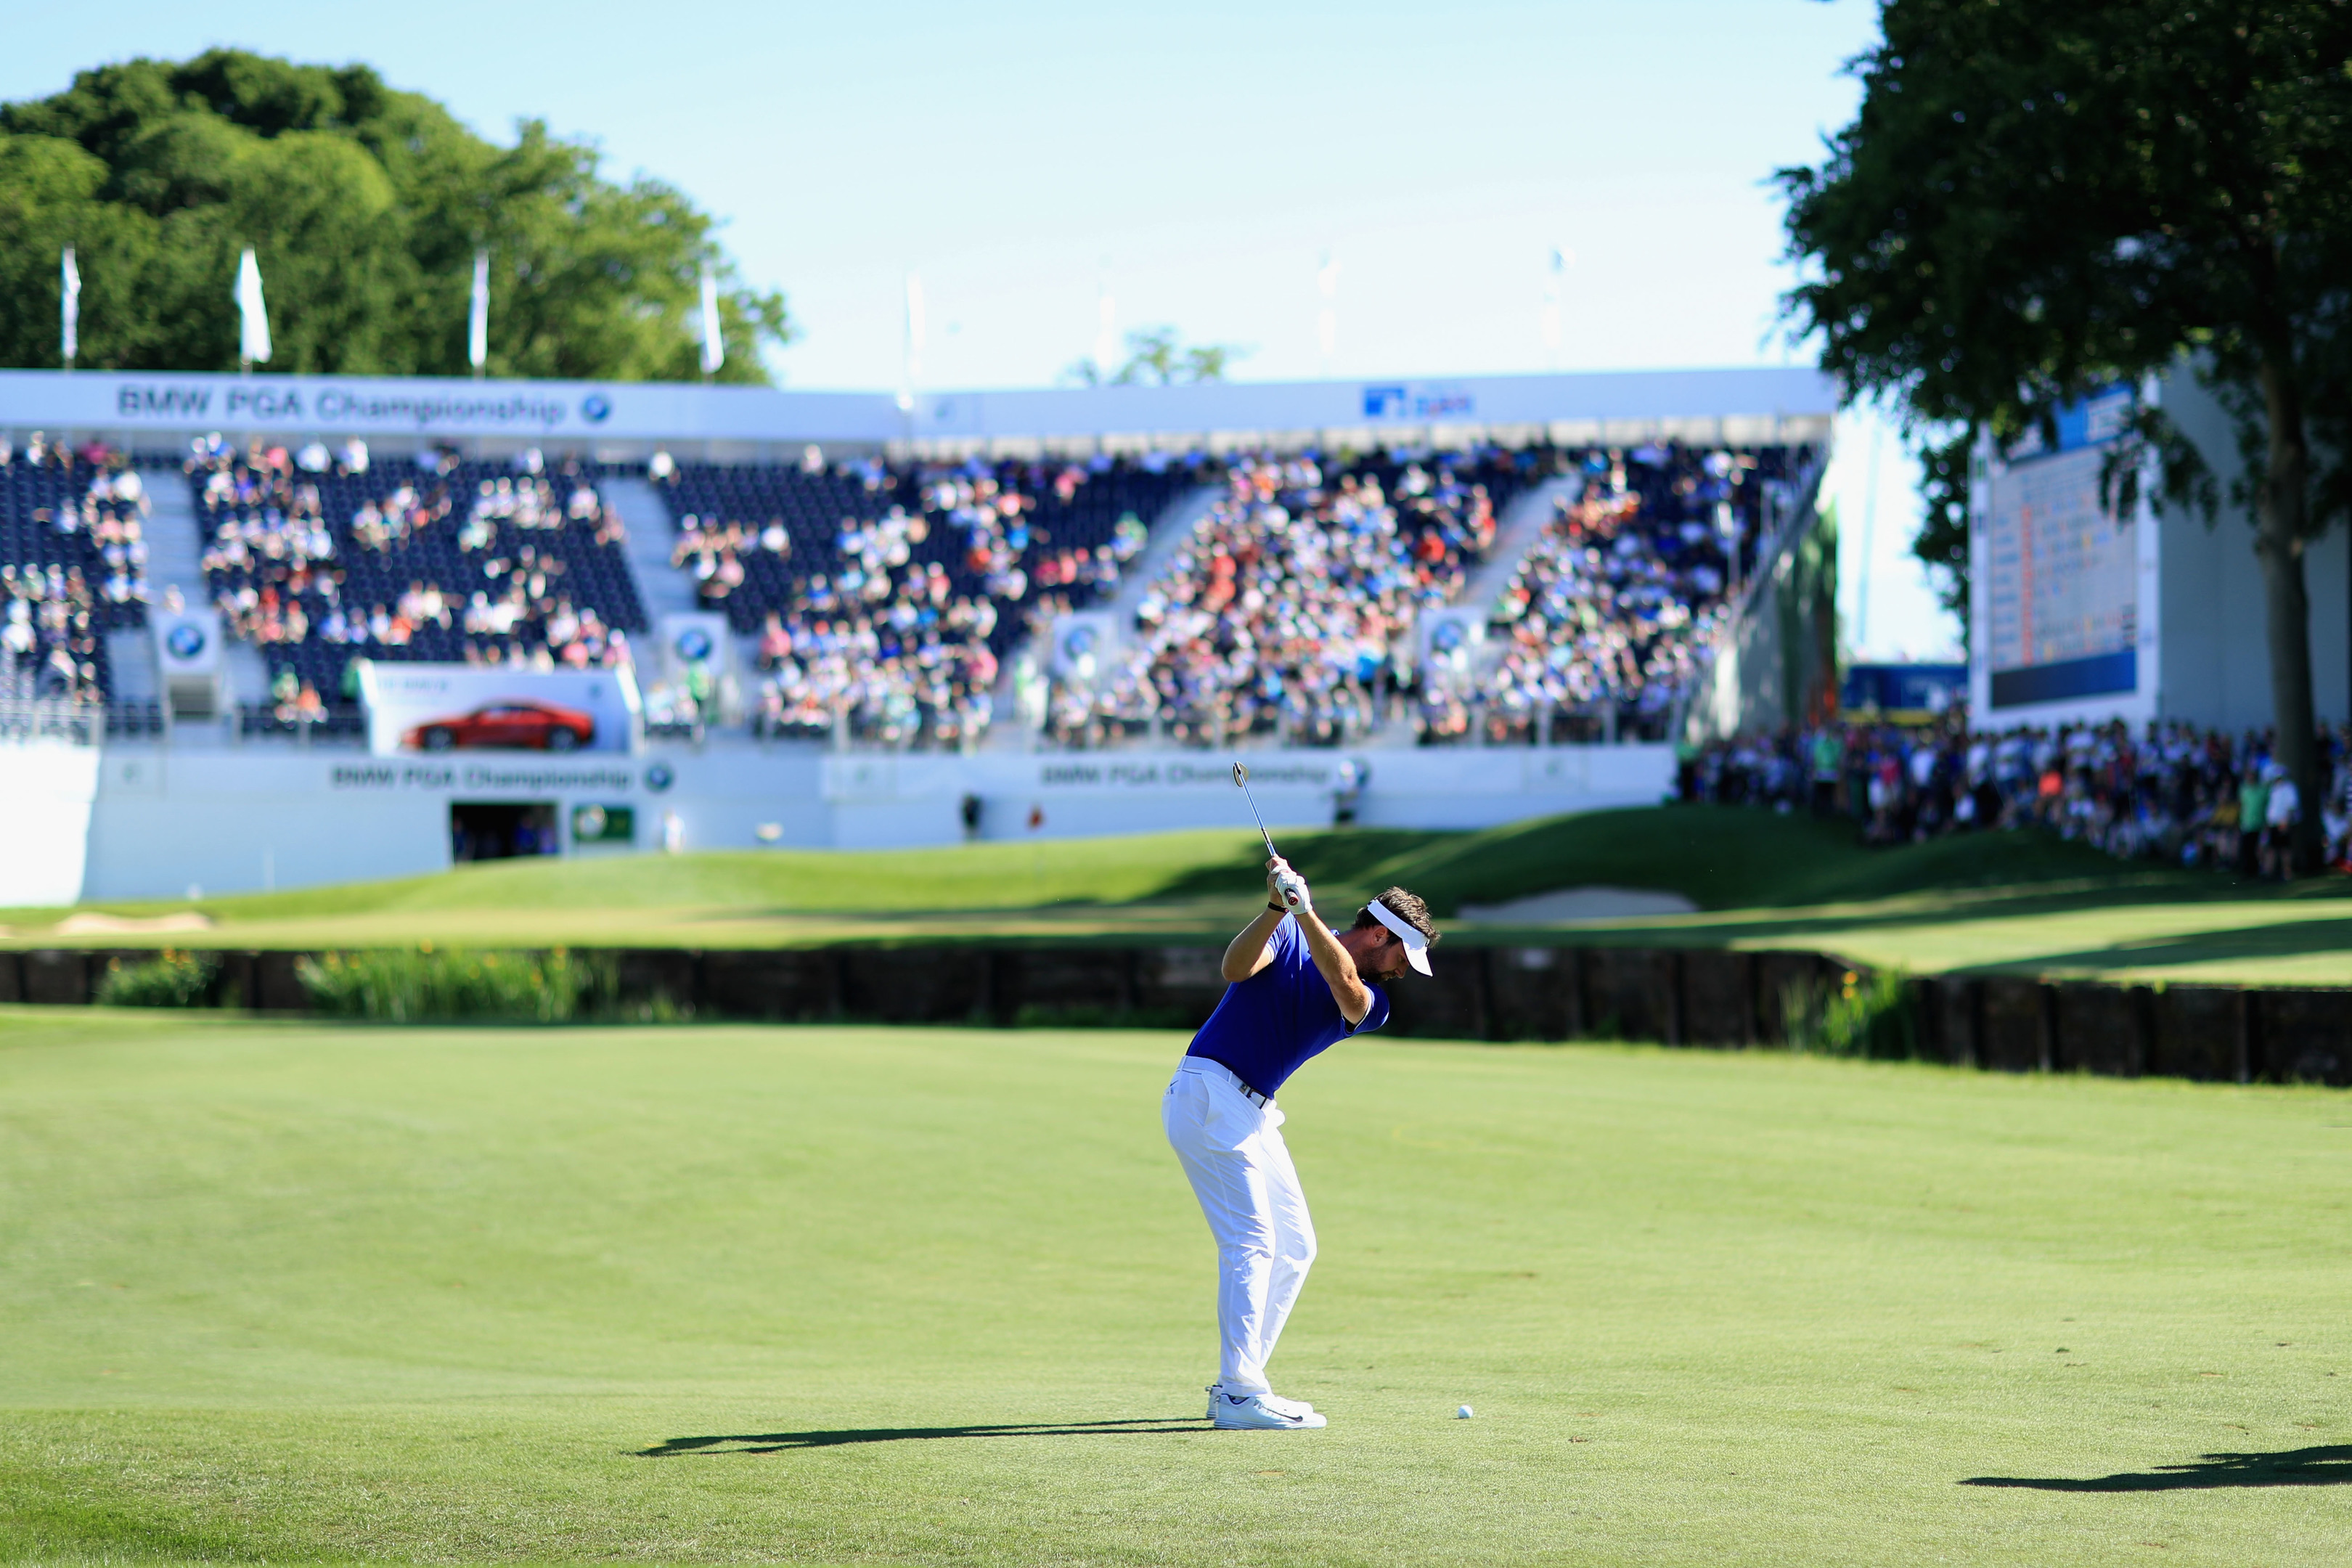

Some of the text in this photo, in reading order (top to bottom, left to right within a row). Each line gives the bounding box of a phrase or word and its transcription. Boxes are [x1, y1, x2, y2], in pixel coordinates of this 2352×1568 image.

[117, 384, 566, 430] BMW PGA Championship
[332, 766, 633, 796] BMW PGA Championship
[1042, 764, 1102, 786] BMW
[1108, 764, 1160, 787] PGA
